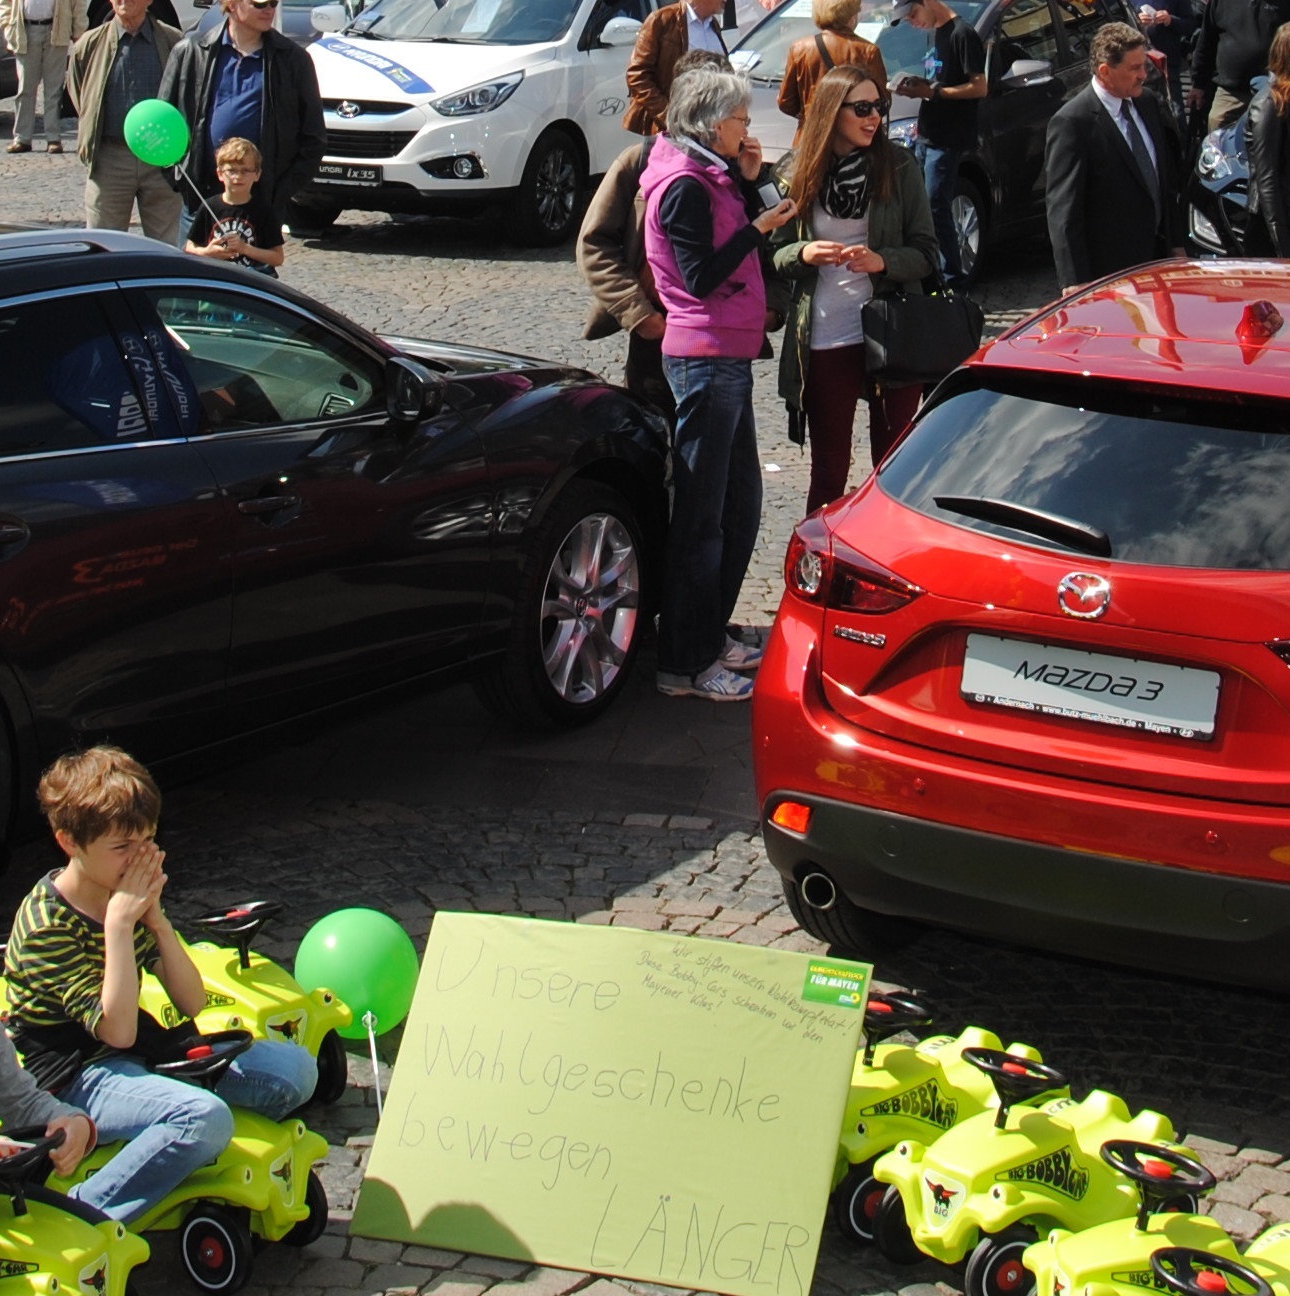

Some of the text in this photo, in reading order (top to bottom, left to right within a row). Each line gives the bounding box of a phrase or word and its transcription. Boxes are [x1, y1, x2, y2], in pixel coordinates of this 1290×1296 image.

[346, 168, 376, 180] ix35
[1137, 680, 1165, 701] 3
[993, 695, 1172, 734] Andernach www.butz-muehlbach.de Mayen
[672, 940, 691, 958] Wir
[435, 939, 622, 1011] Unsere
[810, 975, 859, 991] FÜR MAYEN
[802, 1028, 824, 1045] den
[424, 1024, 781, 1124] Wahlgeschenke
[399, 1092, 613, 1191] bewegen
[933, 1205, 949, 1217] BIG
[588, 1184, 811, 1296] LÄNGER
